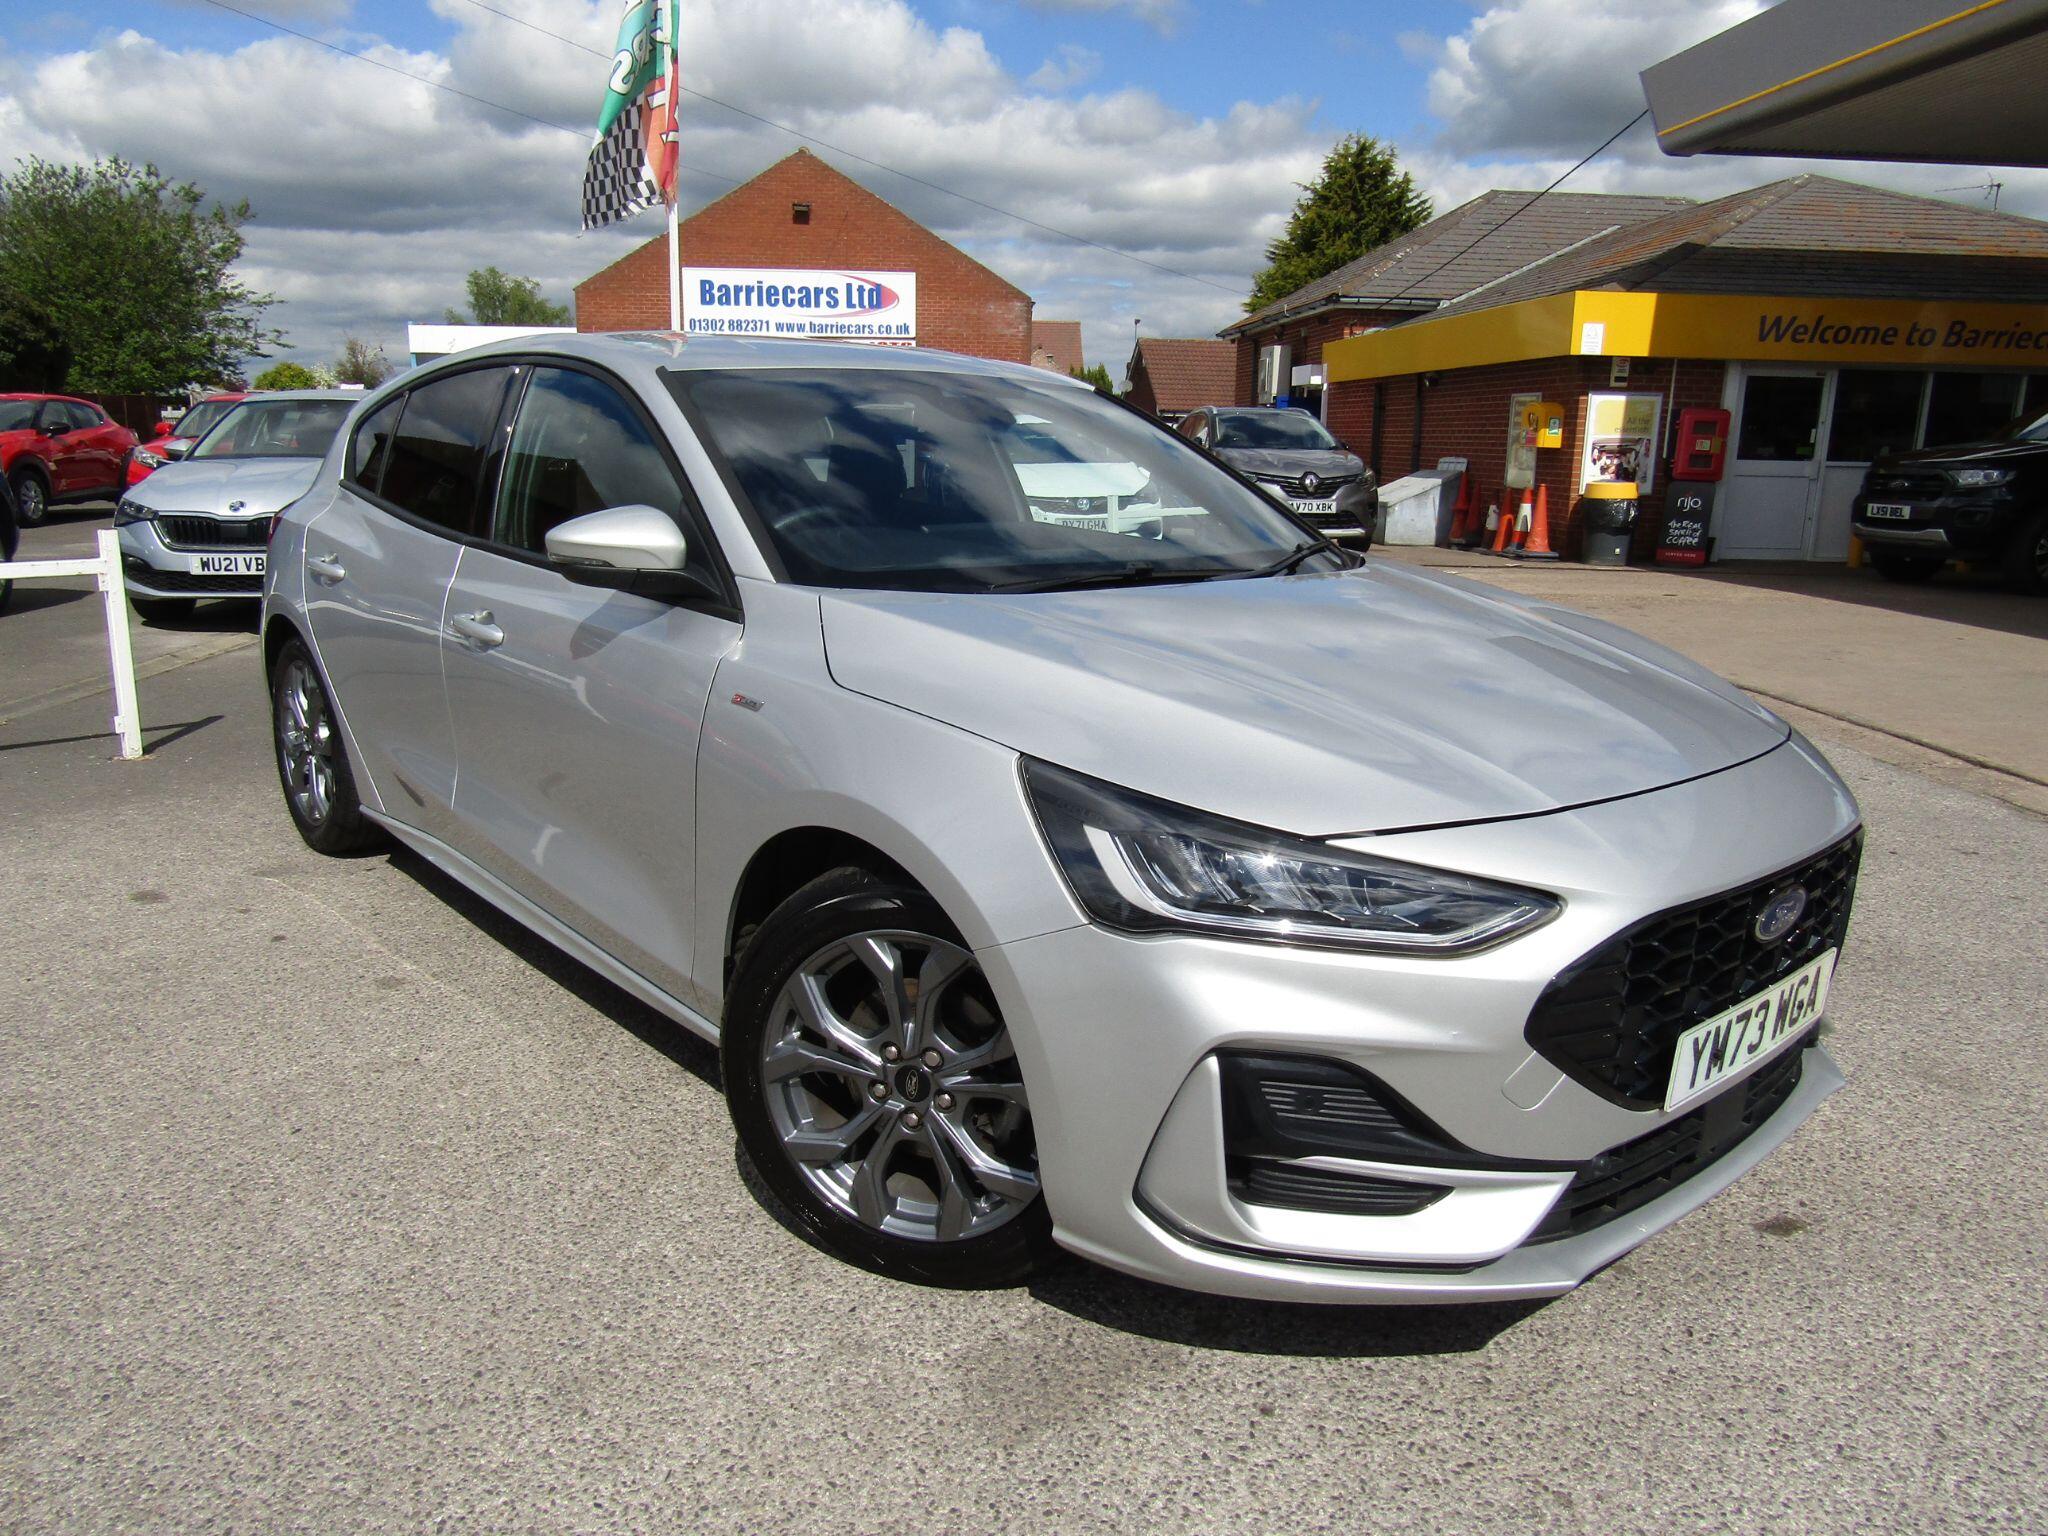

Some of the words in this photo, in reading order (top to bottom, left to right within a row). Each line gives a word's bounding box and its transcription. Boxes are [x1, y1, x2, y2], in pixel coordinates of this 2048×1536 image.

[700, 279, 839, 309] Barriecars
[846, 282, 883, 310] Ltd
[689, 318, 725, 333] 01302
[728, 318, 771, 333] 882371
[775, 320, 910, 335] www.barriecars.co.uk
[1758, 314, 1898, 346] Welcome
[1905, 321, 1937, 347] to
[200, 557, 239, 572] WU21
[1689, 998, 1771, 1090] YM73
